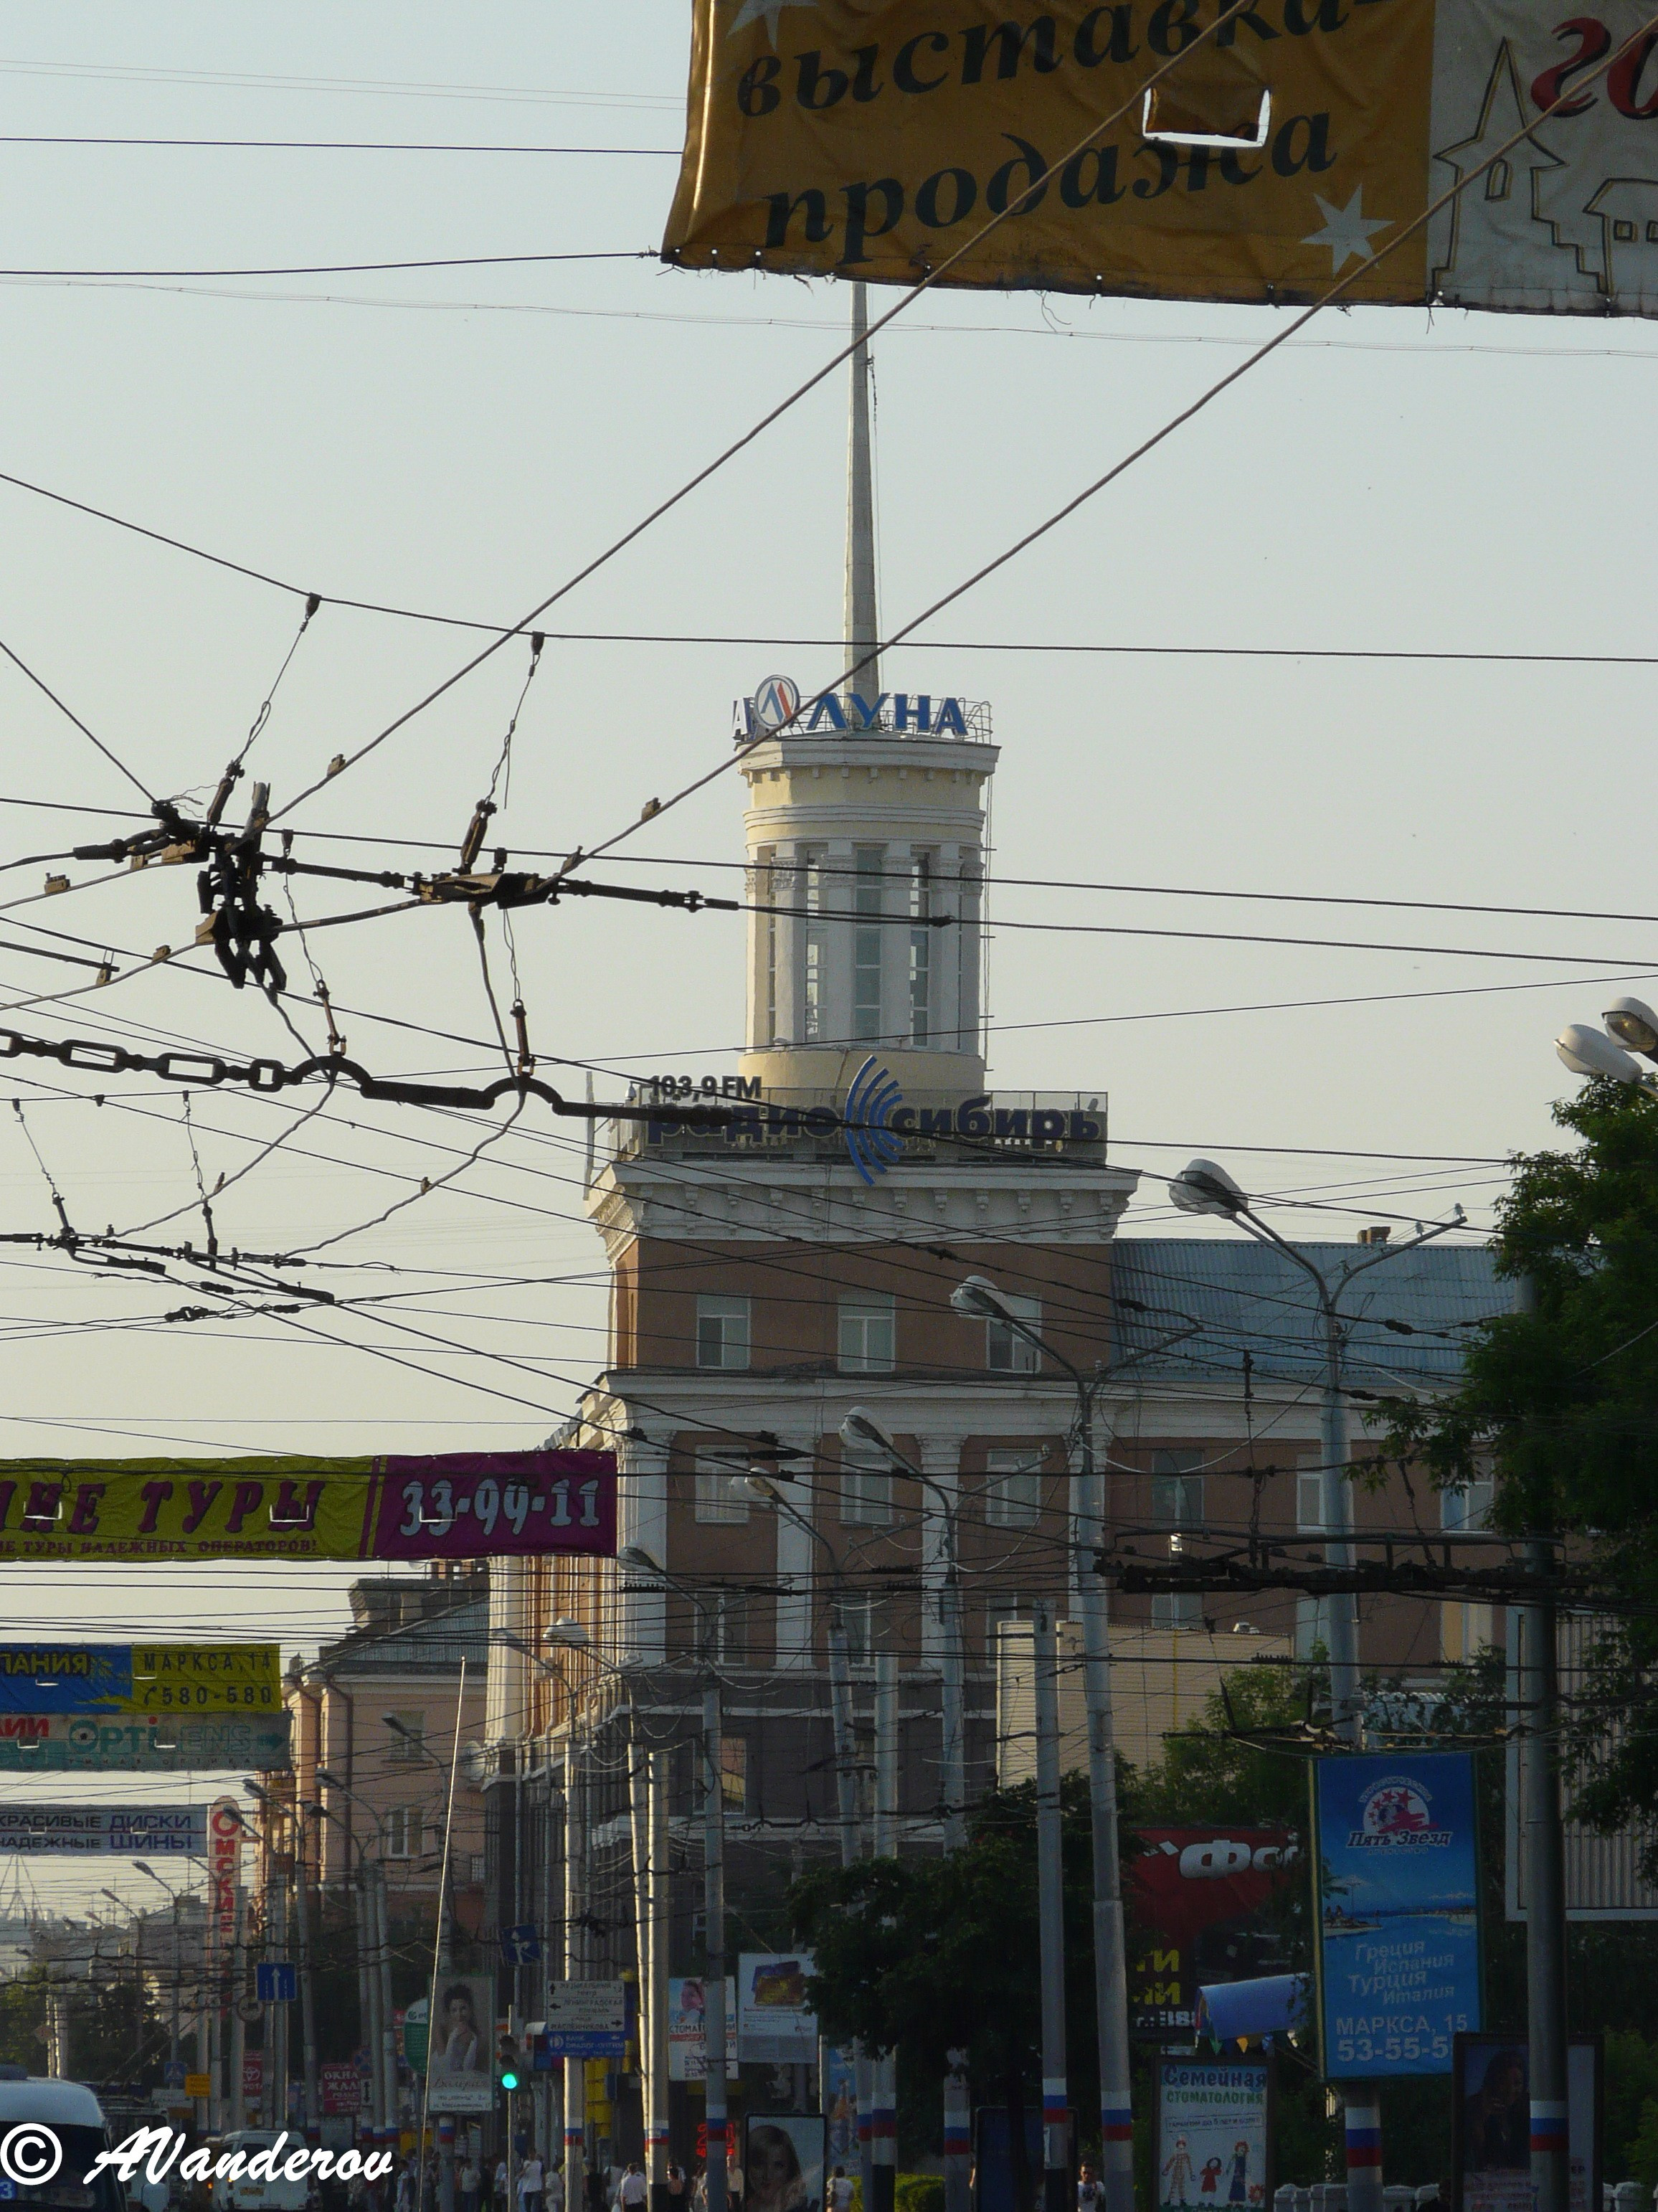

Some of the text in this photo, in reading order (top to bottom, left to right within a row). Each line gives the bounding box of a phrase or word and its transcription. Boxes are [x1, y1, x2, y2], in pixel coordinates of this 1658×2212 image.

[762, 113, 1338, 265] продажа
[805, 691, 969, 737] ЛУНА
[723, 1076, 762, 1098] FM
[892, 1096, 1100, 1150] сибирь
[138, 1480, 325, 1533] ТУРЫ
[399, 1479, 600, 1536] 33-99-11
[162, 1686, 271, 1705] 580-580
[110, 1815, 191, 1832] ДИСКИ
[110, 1835, 192, 1850] ШИНЫ
[1444, 2014, 1468, 2033] 15
